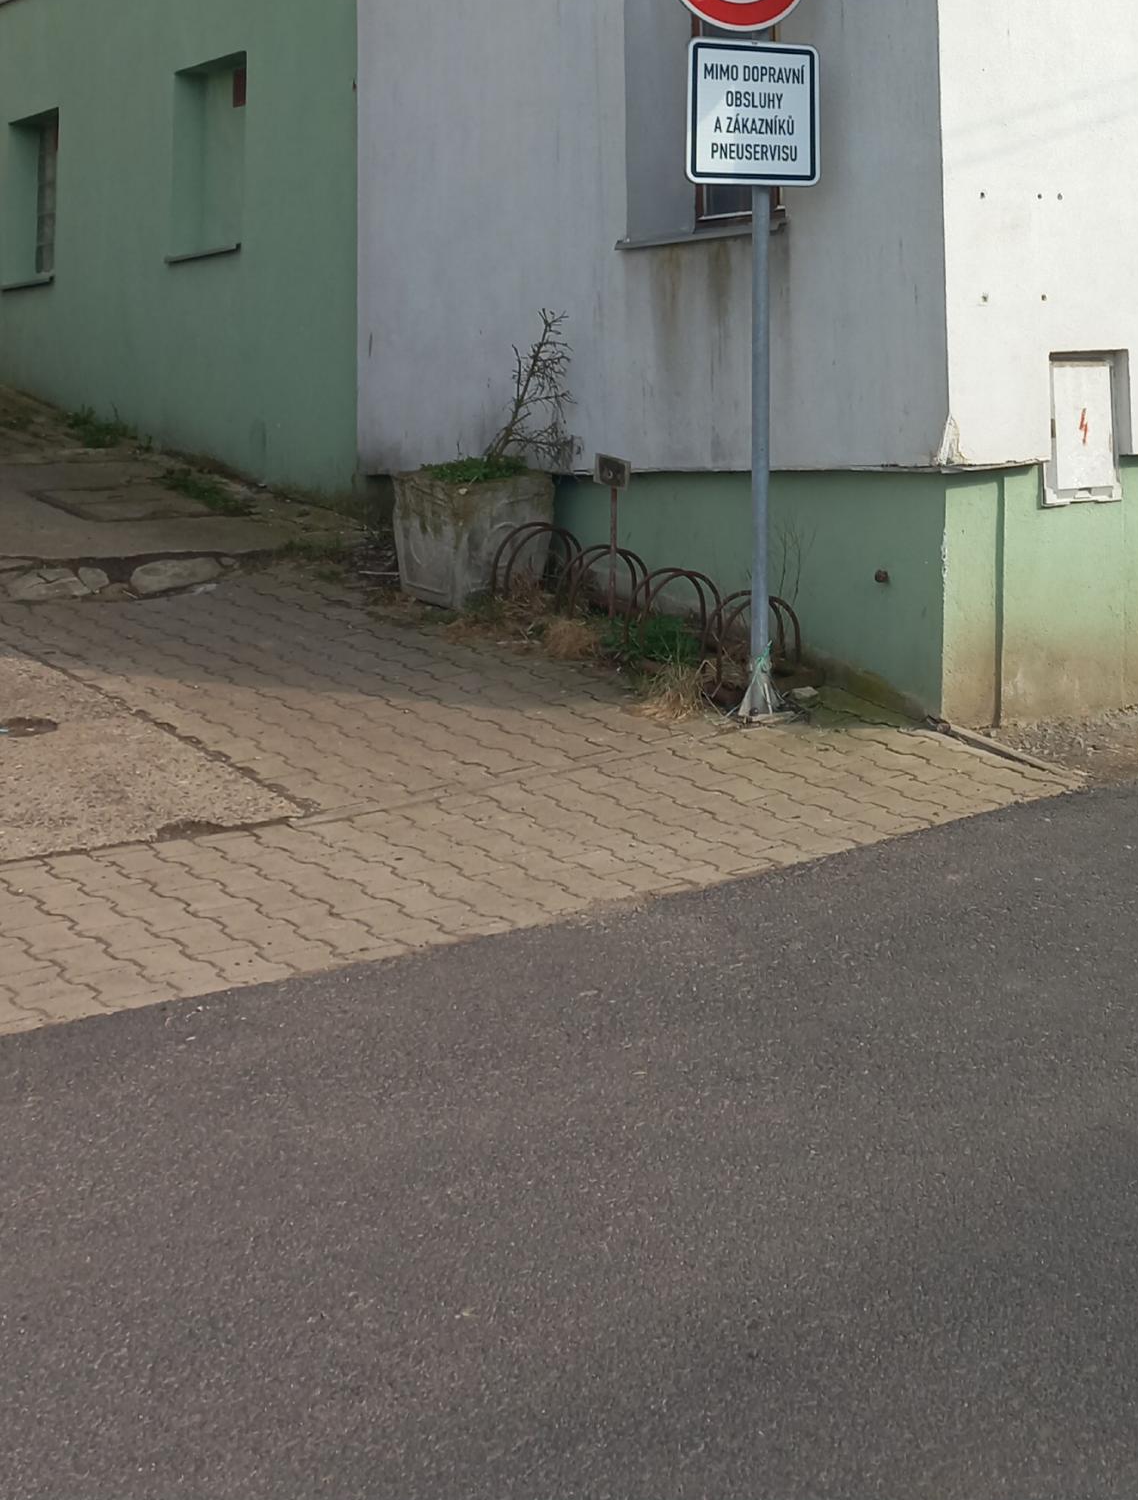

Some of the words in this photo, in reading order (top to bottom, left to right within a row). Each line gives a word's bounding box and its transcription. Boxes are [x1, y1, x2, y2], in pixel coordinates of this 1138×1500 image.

[703, 62, 739, 81] MIMO
[743, 64, 805, 85] DOPRAVNÍ
[725, 90, 784, 109] OBSLUHY
[713, 116, 722, 133] A
[725, 113, 795, 136] ZÁKAZNÍKŮ
[711, 142, 798, 162] PNEUSERVISU
